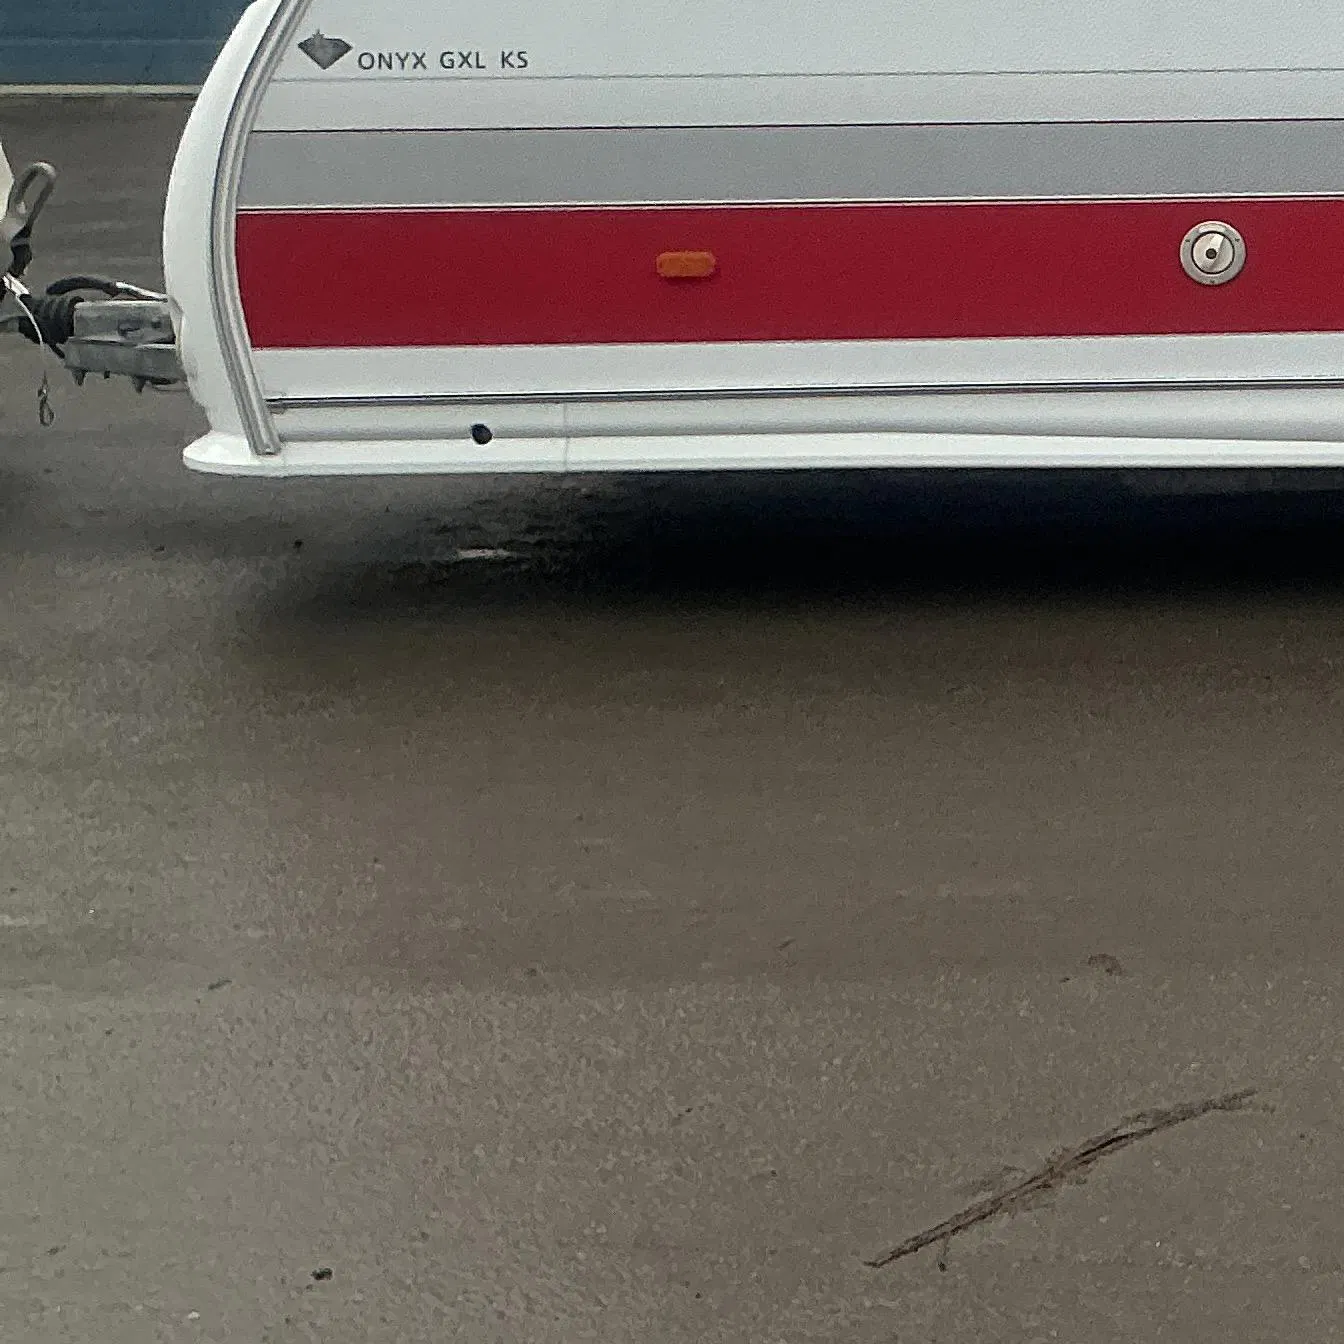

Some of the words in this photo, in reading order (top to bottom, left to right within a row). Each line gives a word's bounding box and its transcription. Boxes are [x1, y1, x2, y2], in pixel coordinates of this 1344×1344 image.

[357, 52, 428, 71] ONYX
[439, 50, 487, 70] GXL
[500, 50, 529, 69] KS
